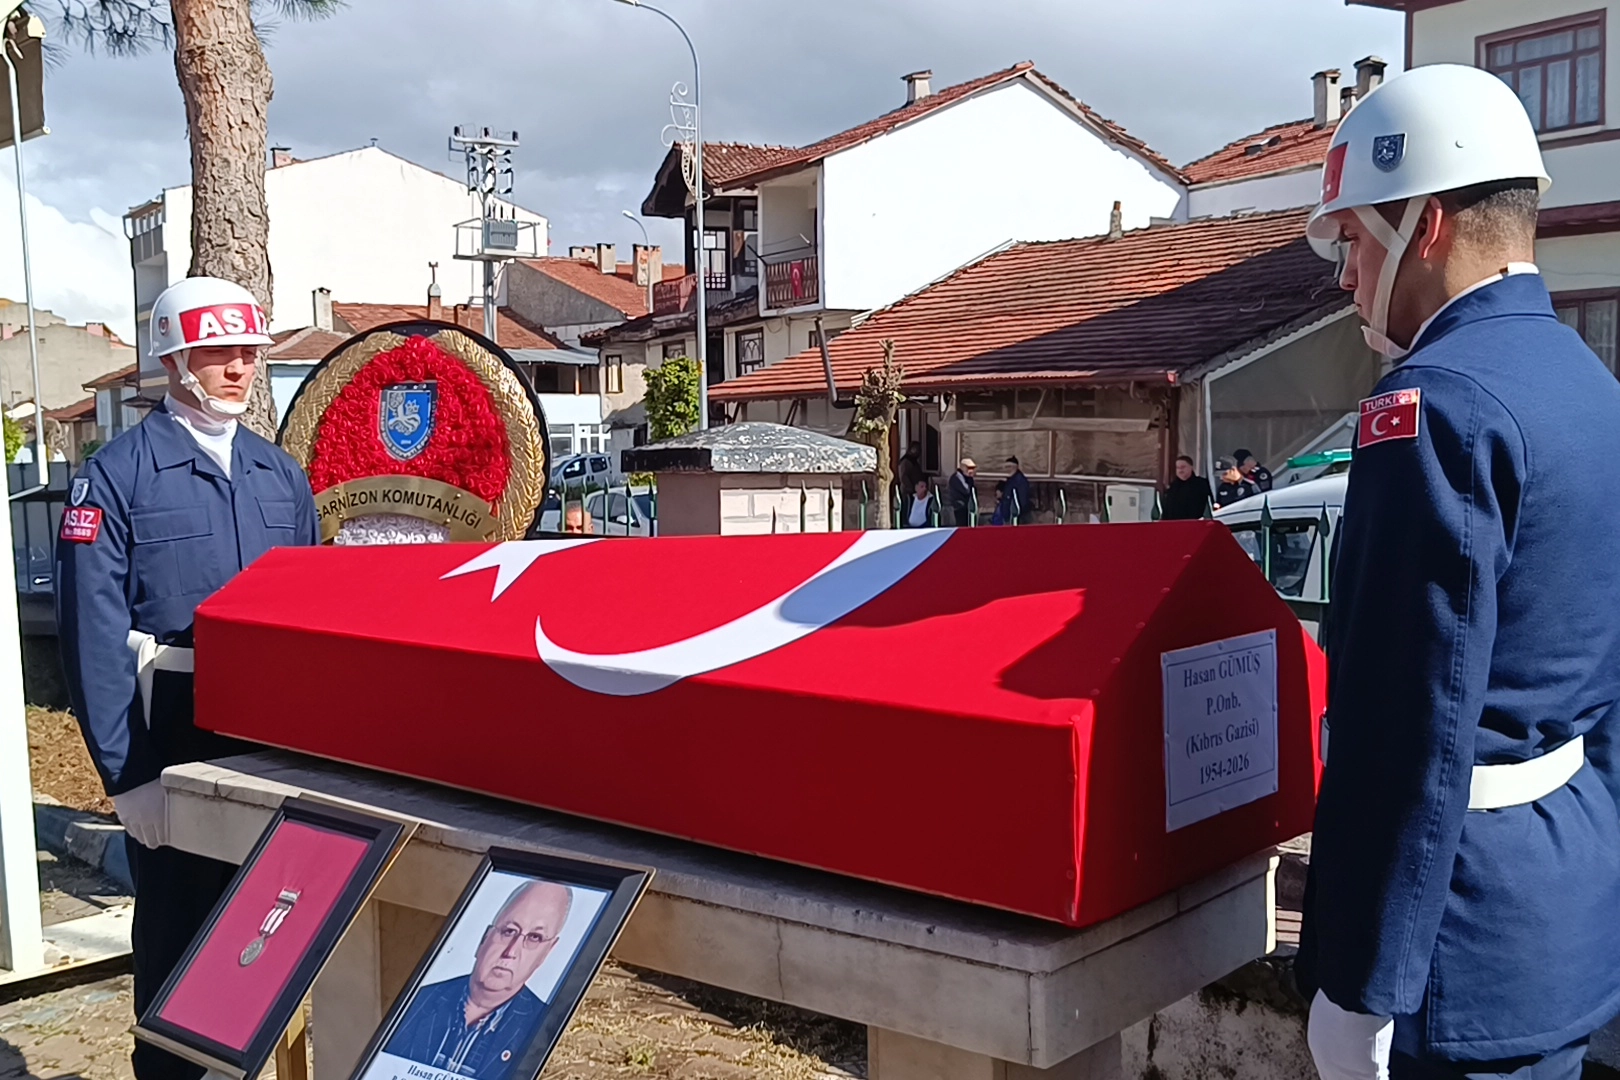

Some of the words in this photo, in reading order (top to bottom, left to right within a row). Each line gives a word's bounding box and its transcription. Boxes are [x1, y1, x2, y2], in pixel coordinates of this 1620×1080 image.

[382, 489, 482, 530] KOMUTANLIĞI
[1183, 665, 1216, 688] Hasan
[1218, 651, 1261, 677] GÜMÜŞ
[1206, 692, 1242, 715] P.Onb.
[1186, 731, 1224, 760] (Kıbrıs
[1225, 718, 1260, 744] Gazisi)
[1200, 752, 1250, 785] 1954-2026
[407, 1064, 434, 1080] Hasan
